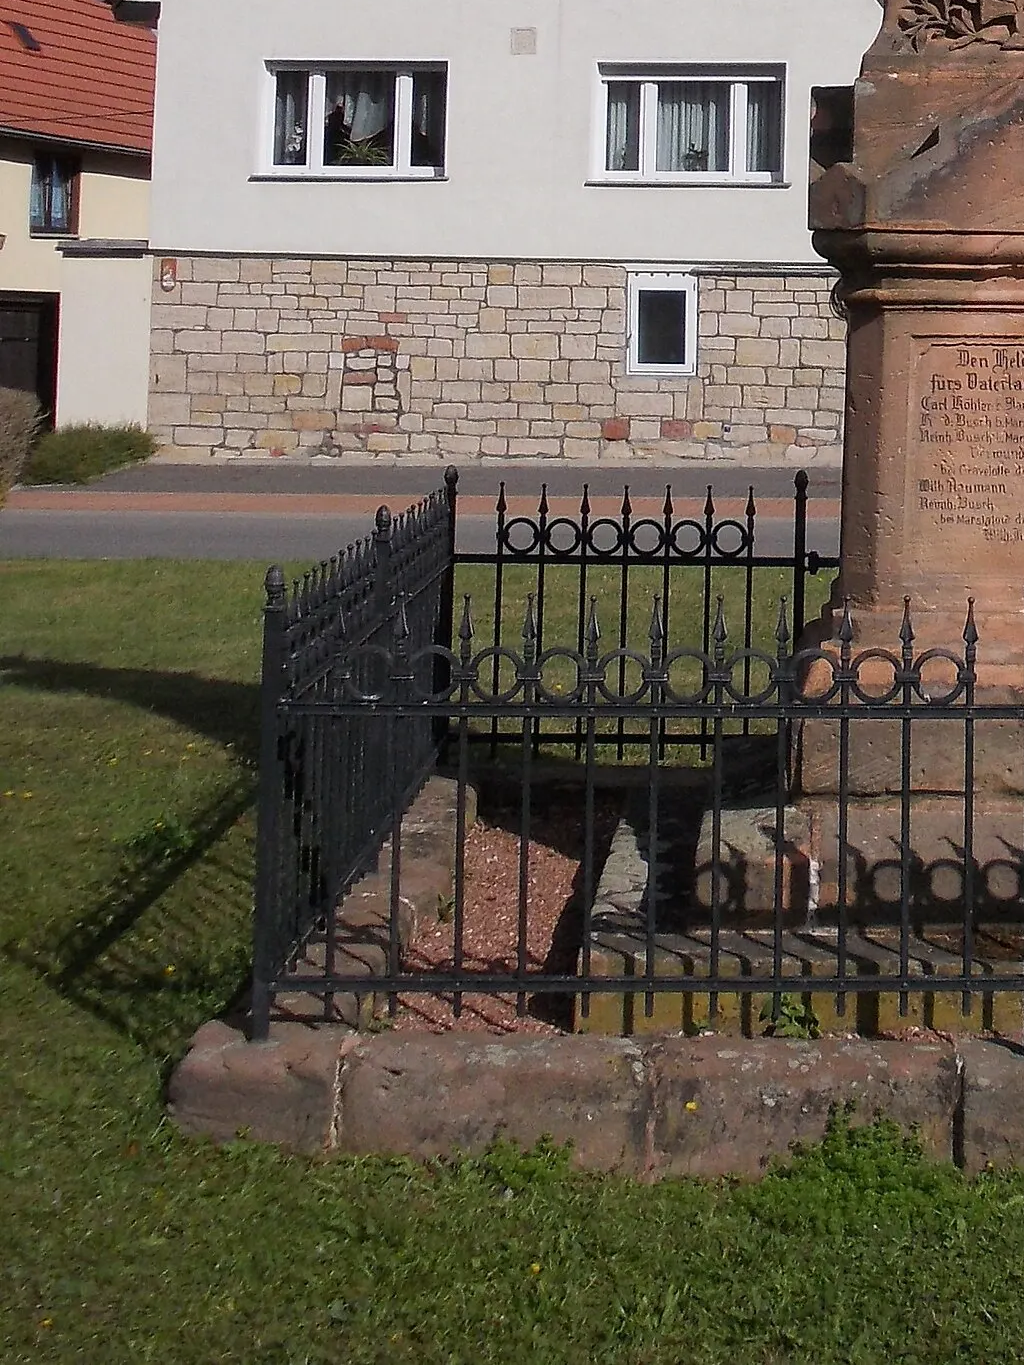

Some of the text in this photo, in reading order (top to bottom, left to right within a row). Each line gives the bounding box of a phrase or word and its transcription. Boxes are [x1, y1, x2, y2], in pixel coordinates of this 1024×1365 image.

[956, 349, 988, 368] Den
[930, 374, 962, 393] fürs
[920, 396, 947, 411] Carl
[952, 395, 992, 411] Köhler
[957, 496, 994, 511] Busch
